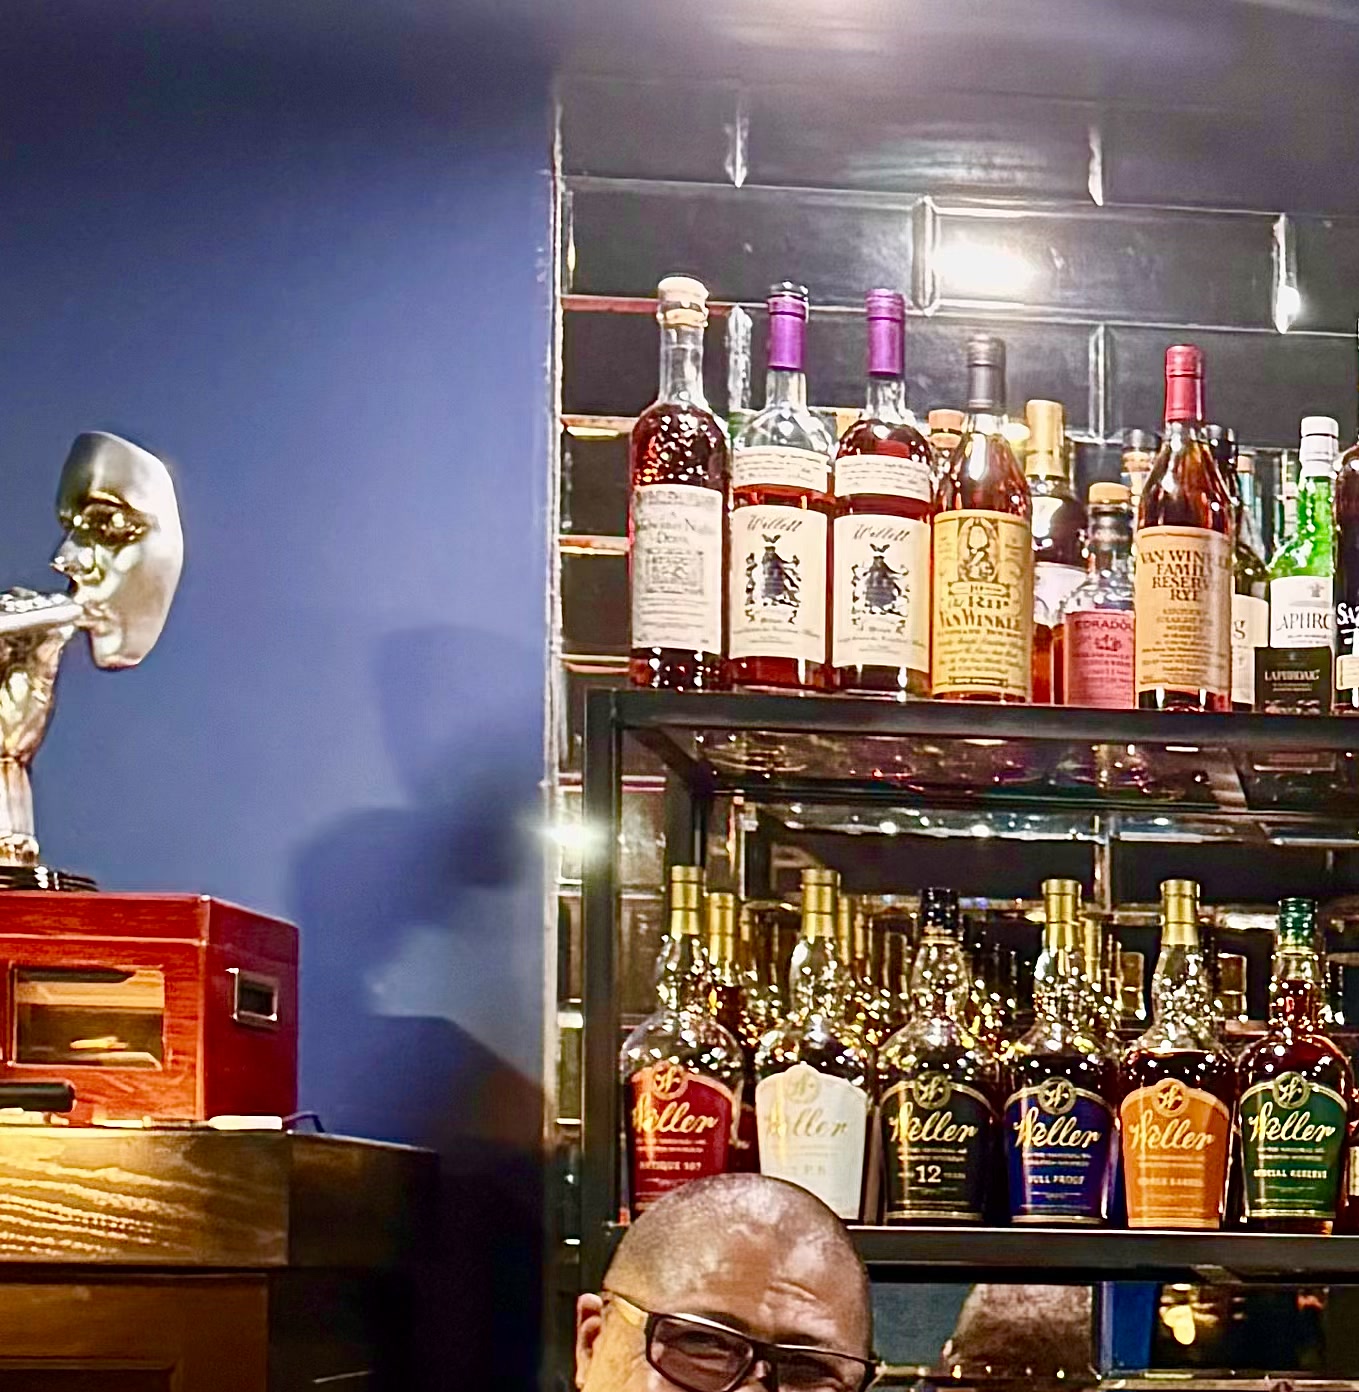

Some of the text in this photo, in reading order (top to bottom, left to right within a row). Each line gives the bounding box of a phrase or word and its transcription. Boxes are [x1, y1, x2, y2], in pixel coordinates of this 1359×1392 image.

[1152, 576, 1210, 589] RESERV
[1170, 589, 1200, 601] RYE
[888, 1101, 979, 1144] Weller
[1013, 1106, 1102, 1149] Weller
[1129, 1109, 1216, 1151] Weller
[1248, 1101, 1337, 1144] Weller
[915, 1164, 942, 1184] 12
